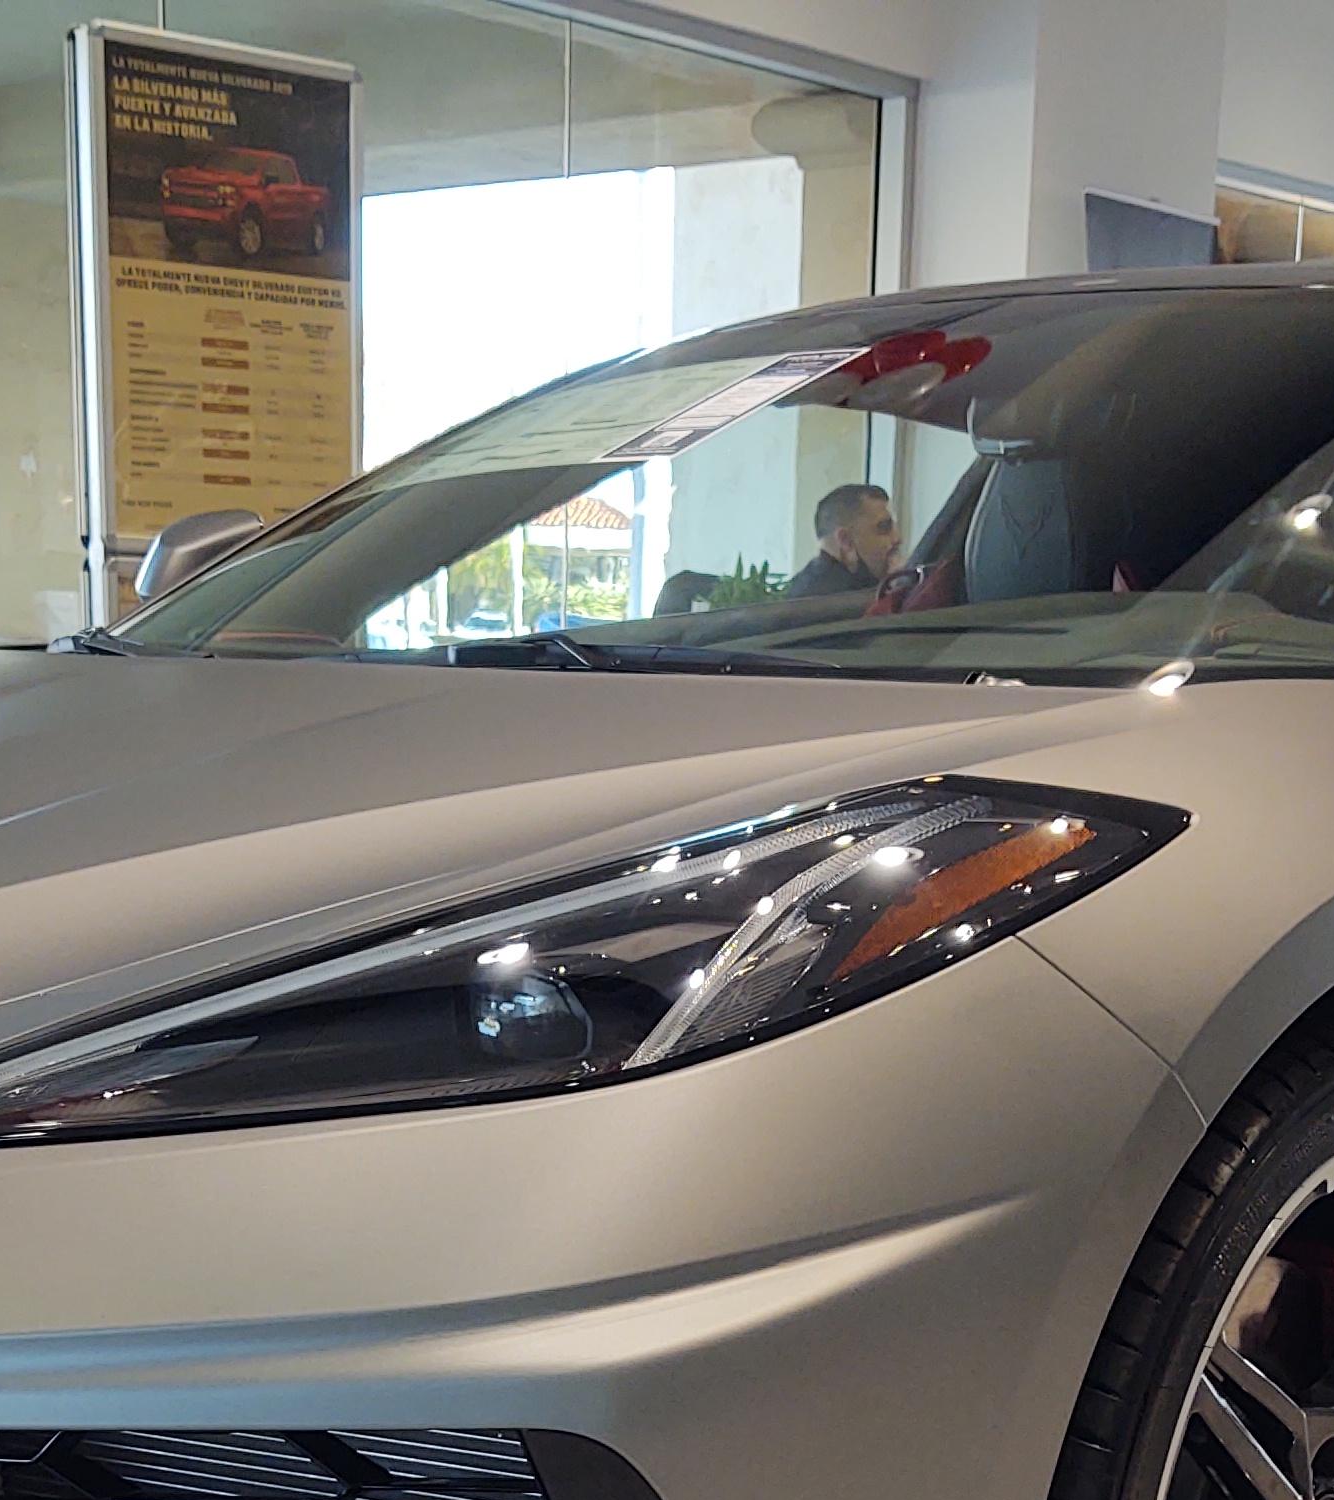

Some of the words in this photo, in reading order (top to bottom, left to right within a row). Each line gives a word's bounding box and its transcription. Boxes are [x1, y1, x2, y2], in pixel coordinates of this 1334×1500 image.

[127, 57, 188, 79] TOTALMENTE
[113, 75, 130, 91] LA
[133, 78, 199, 101] SILVERADO
[114, 95, 160, 114] FUERTE
[163, 100, 172, 115] Y
[175, 102, 236, 125] AVANZADA
[114, 115, 131, 129] EN
[133, 117, 150, 131] LA
[152, 119, 212, 140] HISTORIA.
[116, 278, 149, 290] OFRECE
[185, 286, 245, 300] CONVENIENCIA
[254, 292, 298, 304] CAPACIDAD
[300, 297, 317, 307] POR
[122, 267, 133, 276] LA
[136, 267, 191, 282] TOTALMENTE
[194, 273, 221, 285] NUEVA
[223, 275, 251, 288] CHEVY
[252, 279, 295, 293] SILVERADO
